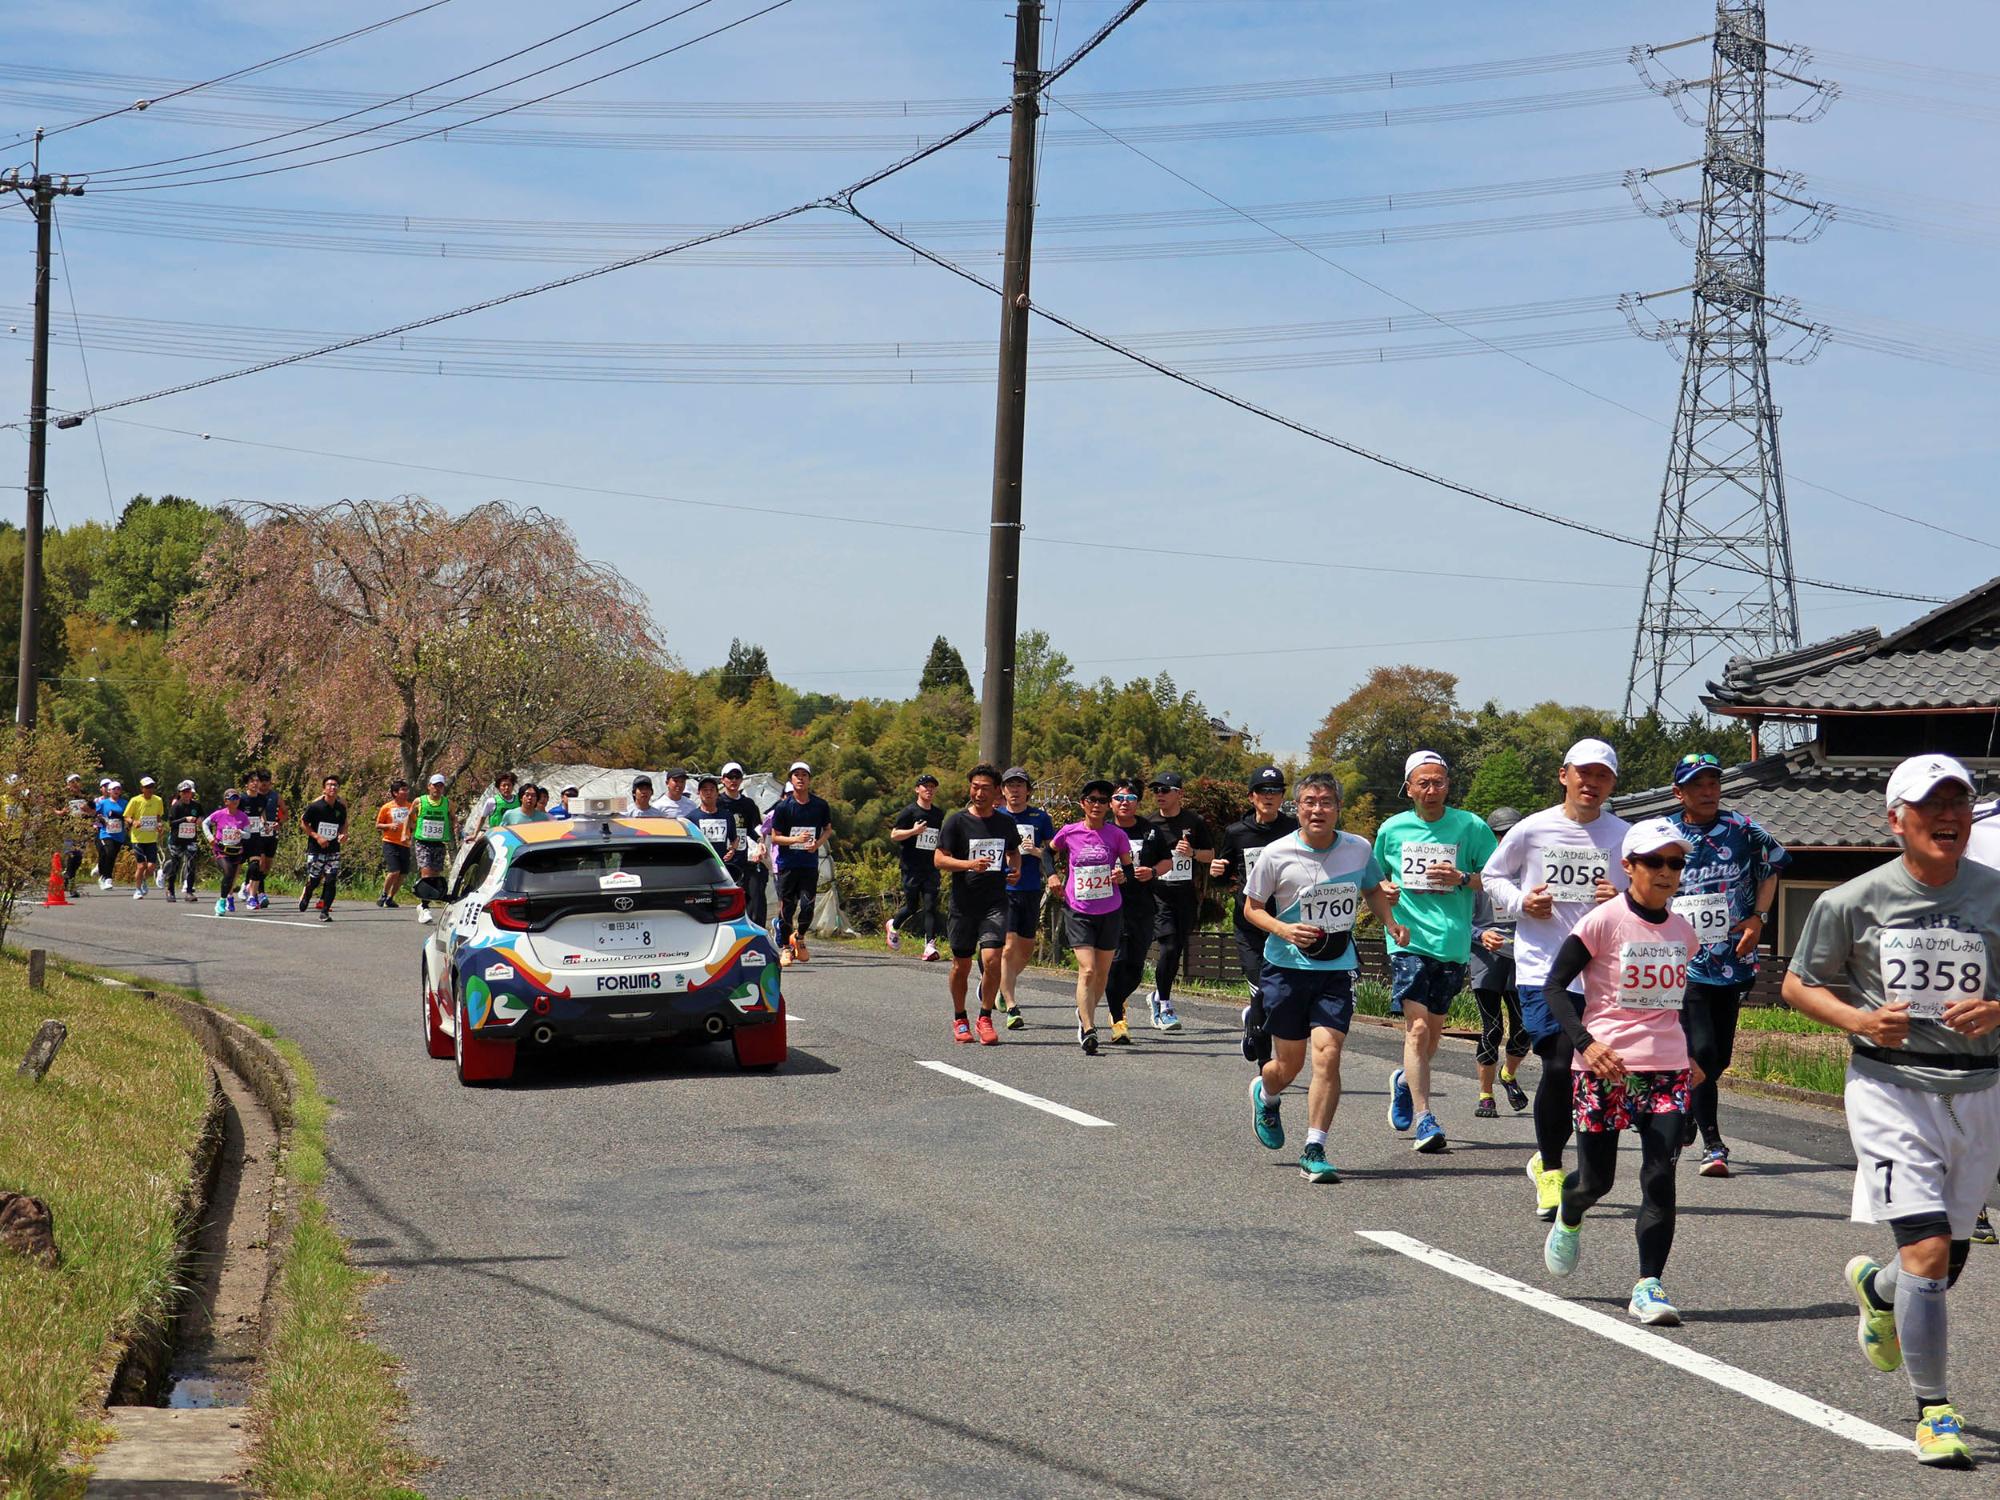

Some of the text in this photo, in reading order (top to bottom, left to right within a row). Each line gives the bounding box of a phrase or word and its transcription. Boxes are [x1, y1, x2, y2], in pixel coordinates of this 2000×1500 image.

[320, 827, 337, 837] 1132
[424, 825, 443, 834] 1338
[703, 826, 726, 836] 1417
[1076, 875, 1111, 890] 3424
[1545, 864, 1606, 886] 2058
[1302, 898, 1354, 921] 1760
[1915, 913, 1961, 930] THE
[597, 972, 662, 991] FORUM8
[1623, 964, 1687, 990] 3508
[1886, 958, 1982, 994] 2358
